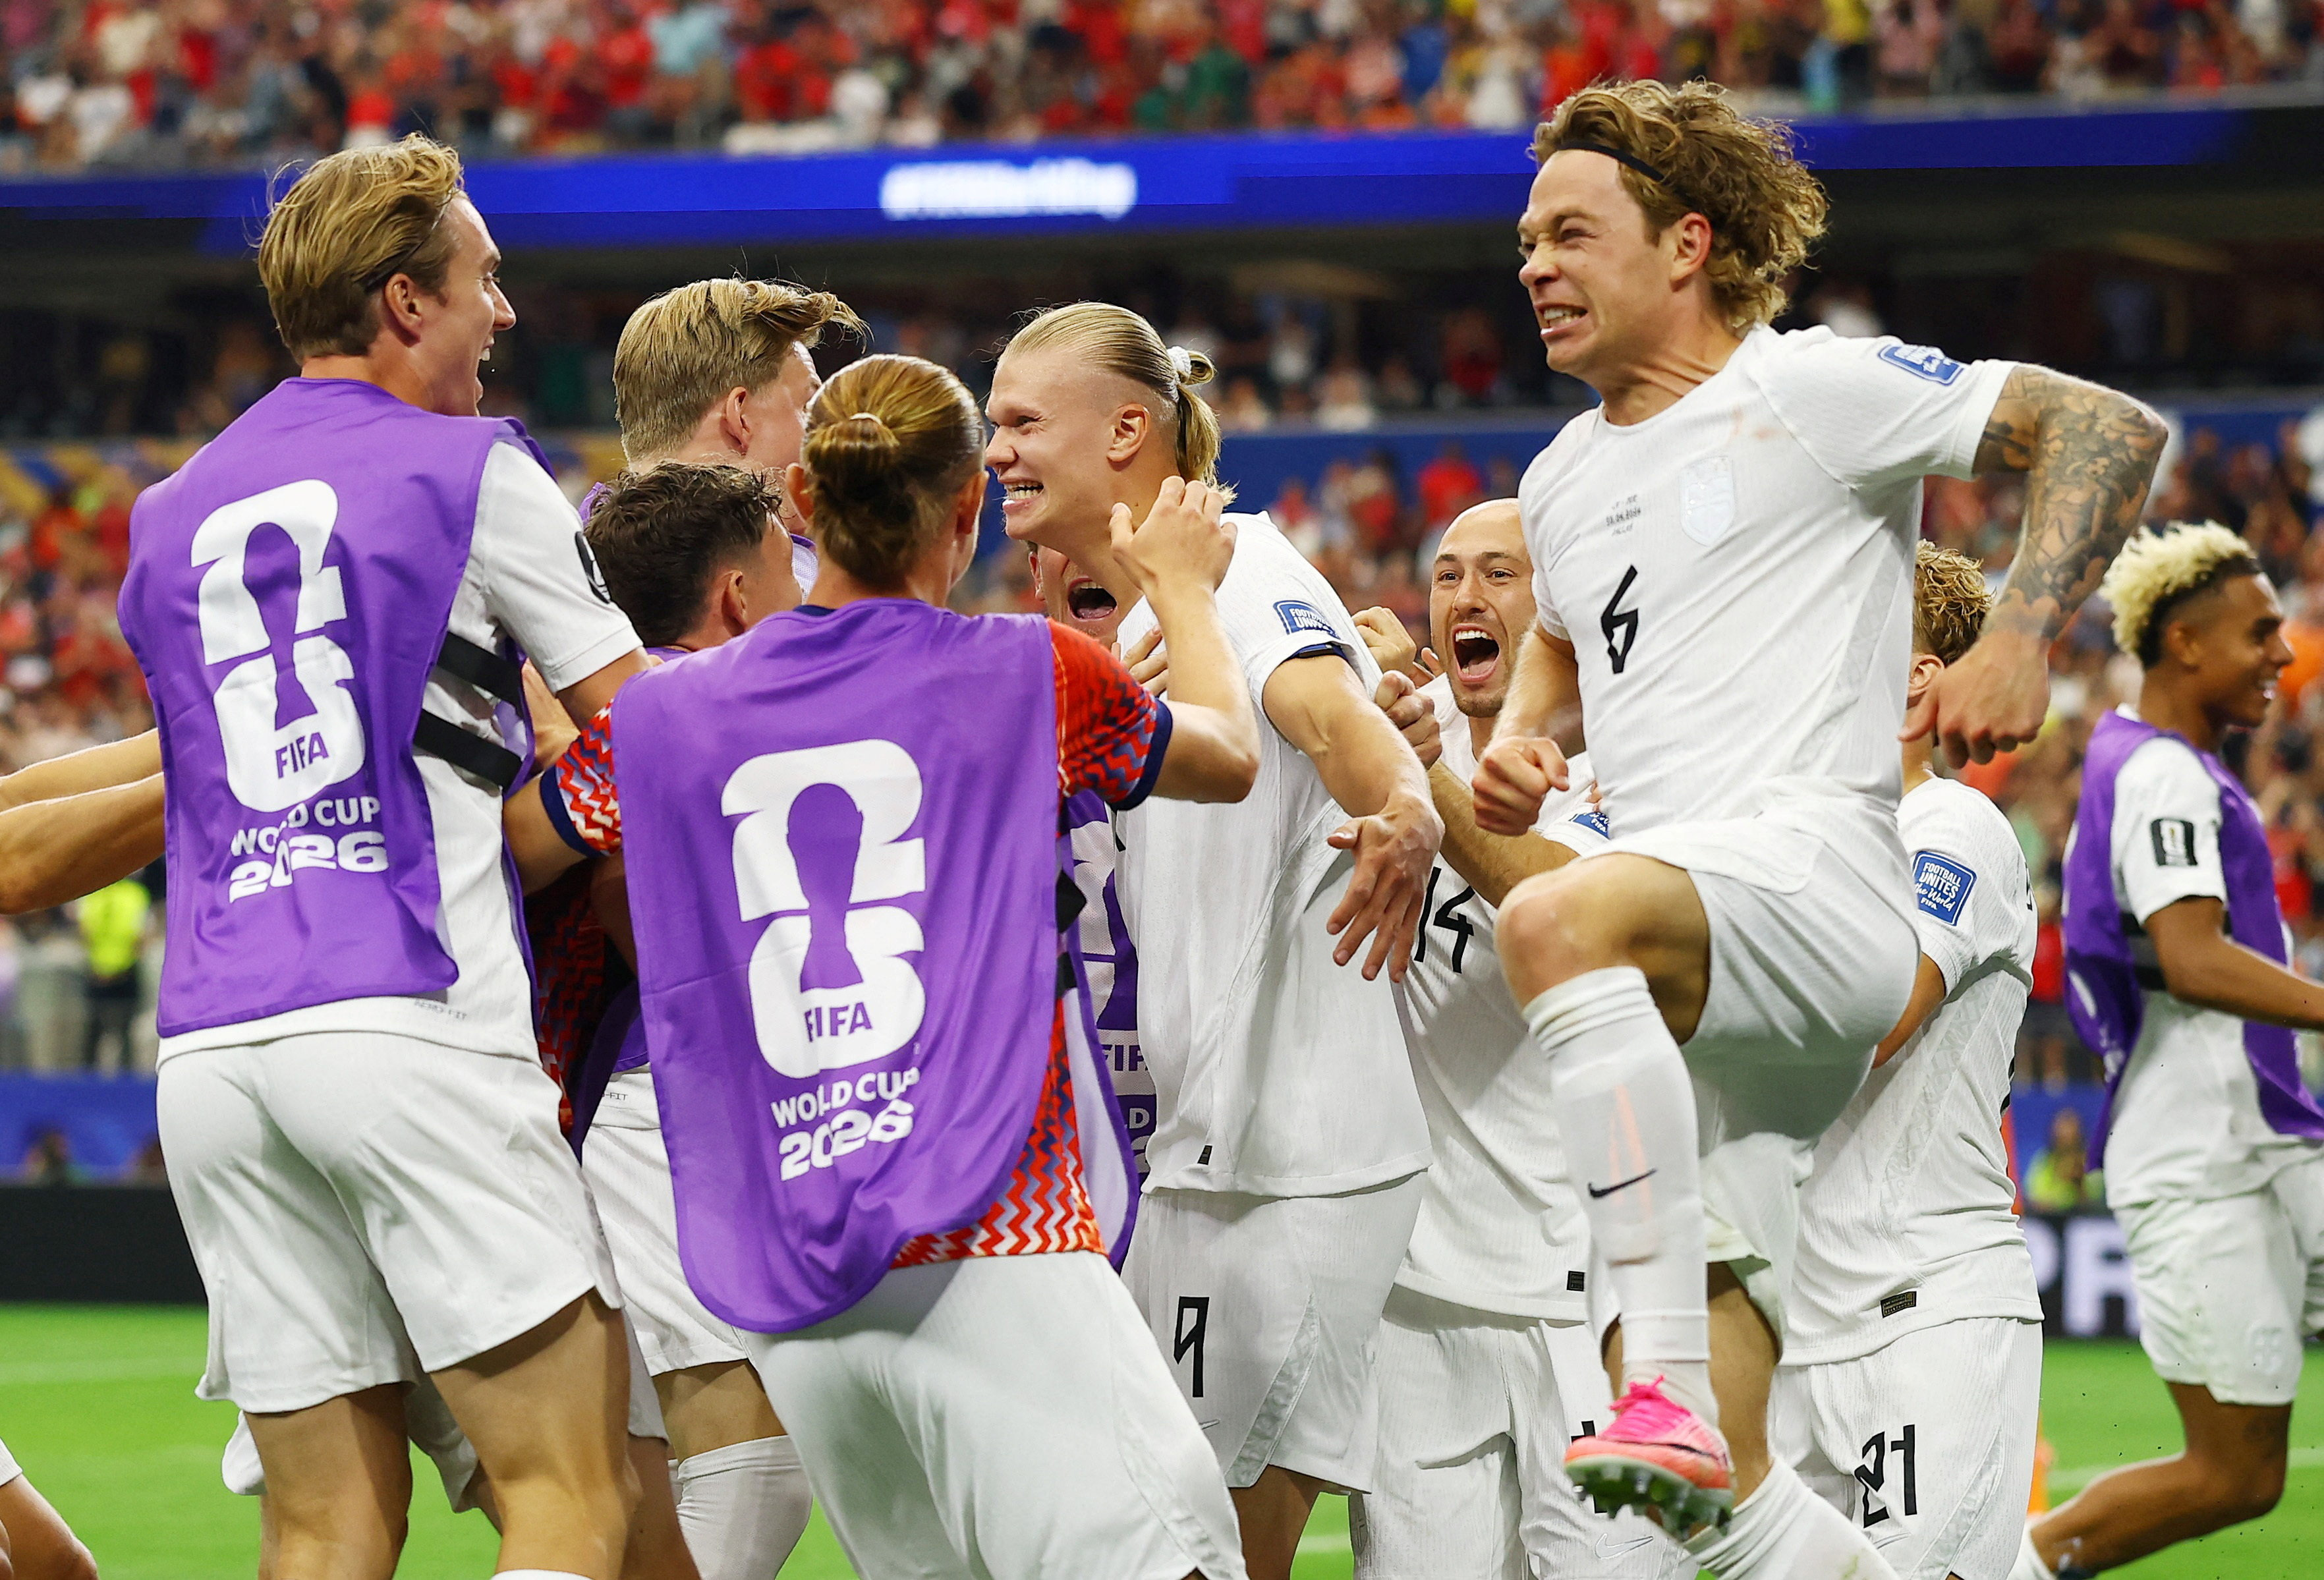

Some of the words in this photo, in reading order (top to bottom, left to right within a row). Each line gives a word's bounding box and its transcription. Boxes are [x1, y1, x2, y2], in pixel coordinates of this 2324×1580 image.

[1601, 564, 1639, 675] 6
[275, 731, 329, 779] FIFA
[314, 796, 381, 827] CUP
[229, 830, 390, 904] 2026
[1918, 872, 1959, 899] UNITES
[1923, 862, 1962, 888] FOOTBALL
[1414, 866, 1476, 974] 14
[1913, 882, 1928, 895] the
[1927, 888, 1956, 912] World
[1920, 897, 1938, 910] FIFA
[804, 1002, 873, 1042] FIFA
[778, 1098, 915, 1181] 2026
[1174, 1296, 1210, 1397] 9
[1854, 1424, 1917, 1529] 21
